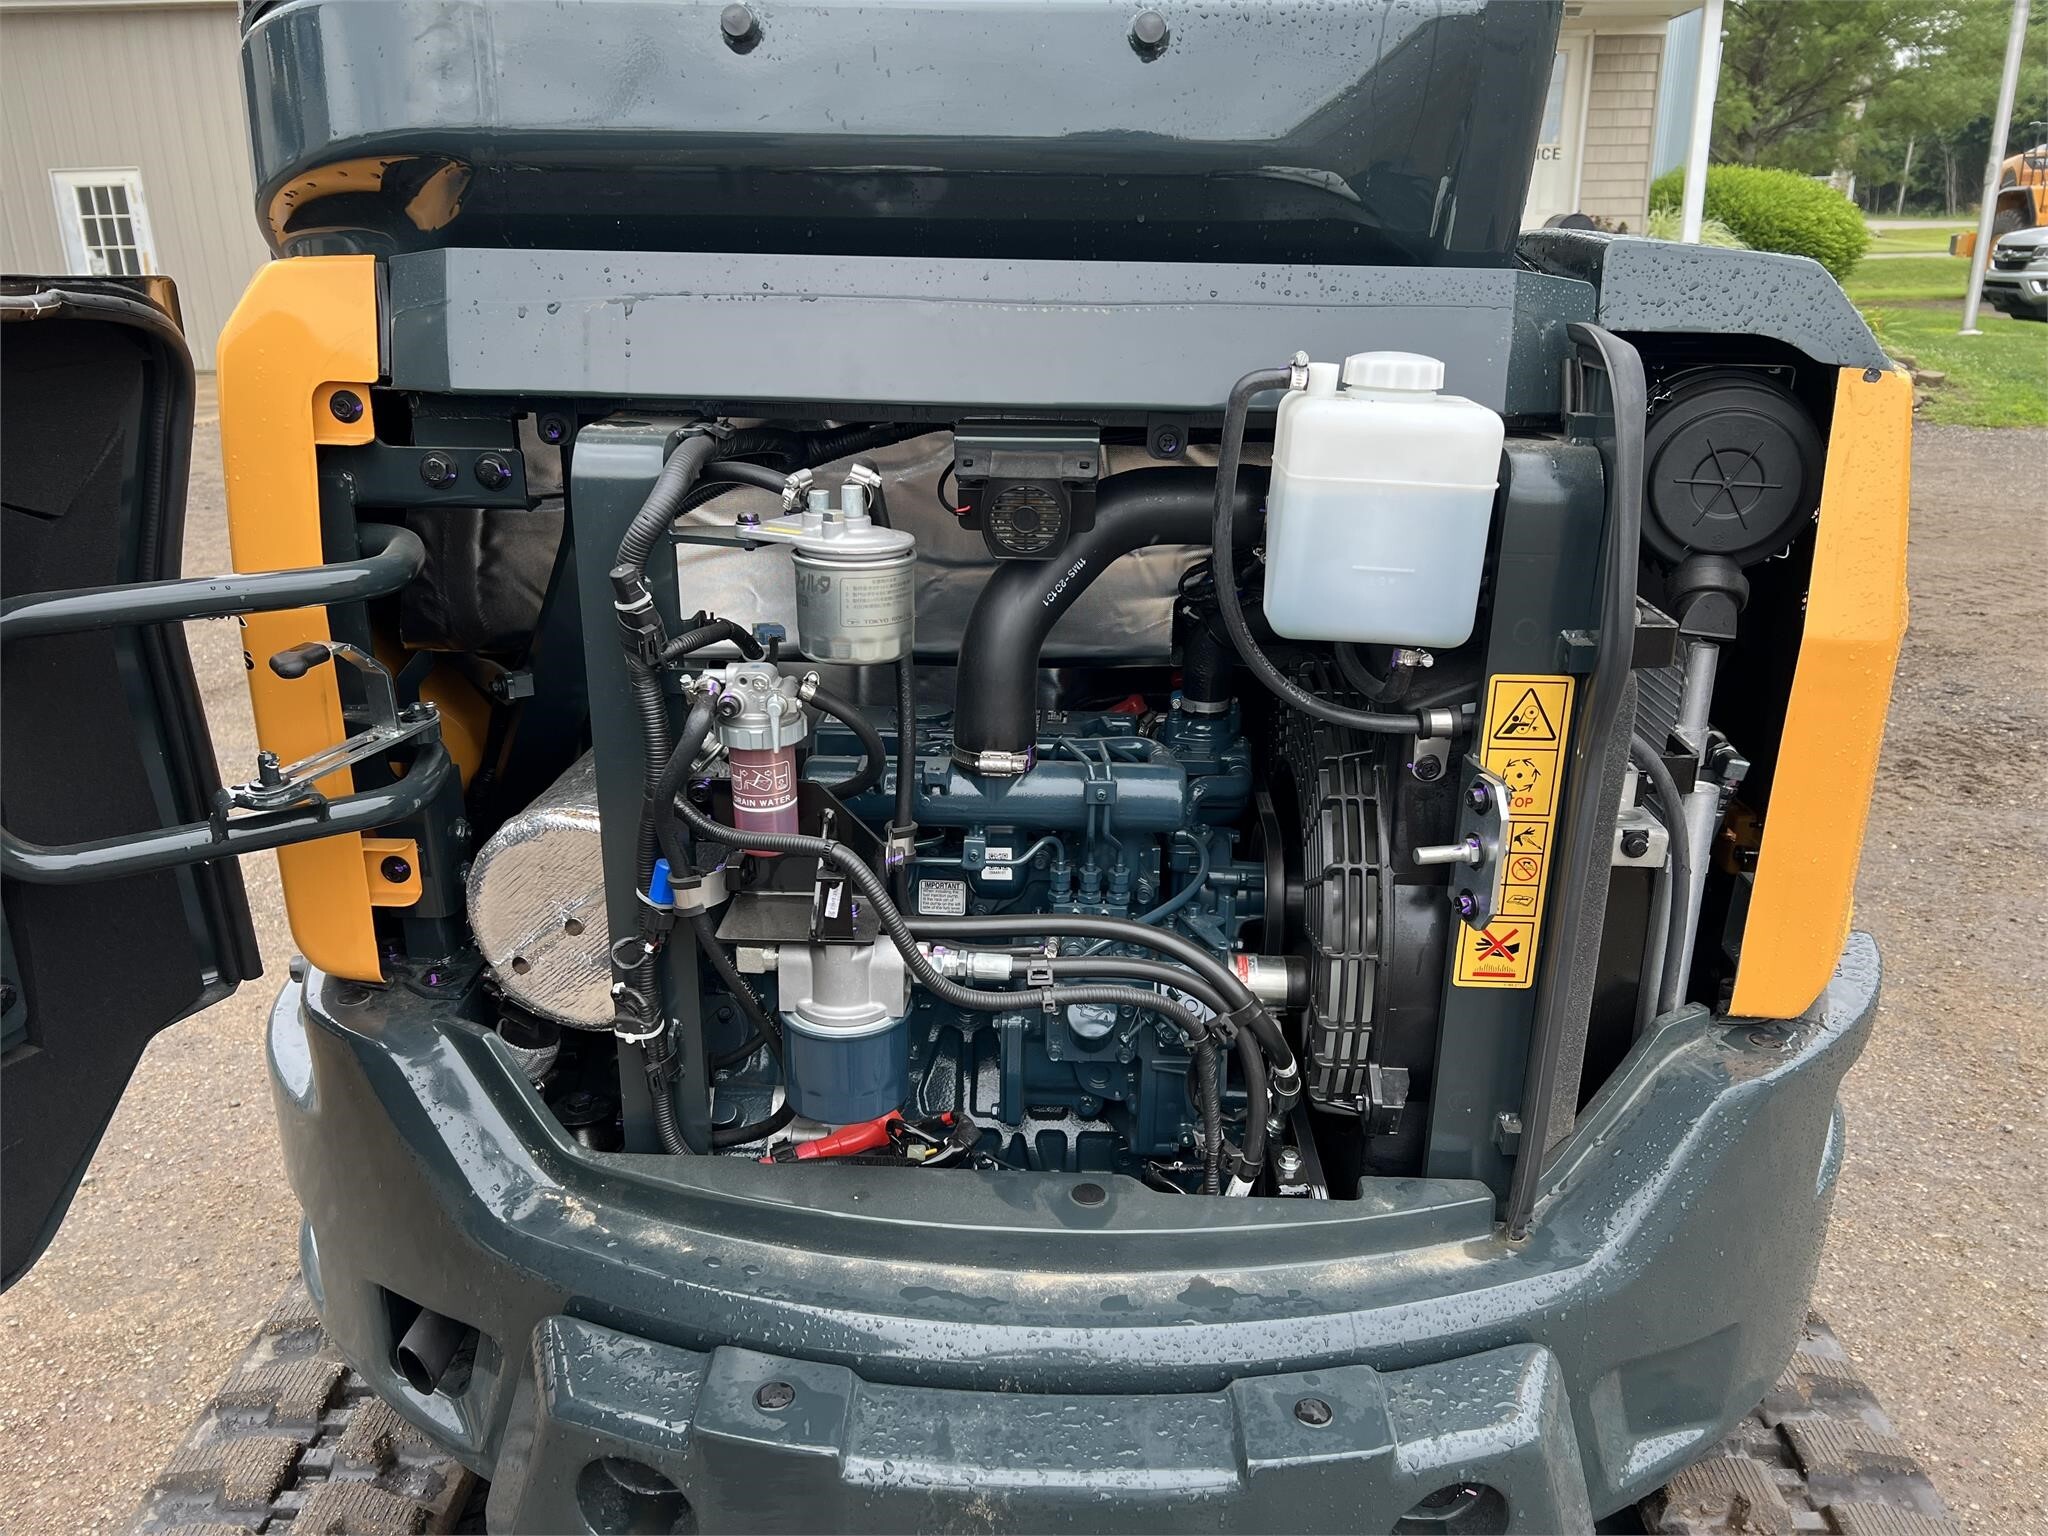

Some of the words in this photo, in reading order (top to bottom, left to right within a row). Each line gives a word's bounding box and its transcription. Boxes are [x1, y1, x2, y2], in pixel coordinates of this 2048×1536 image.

[1042, 557, 1087, 606] 11MS-20101
[734, 795, 756, 807] DRAIN
[759, 794, 791, 807] WATER
[1510, 796, 1534, 808] OP
[924, 882, 961, 890] IMPORTANT
